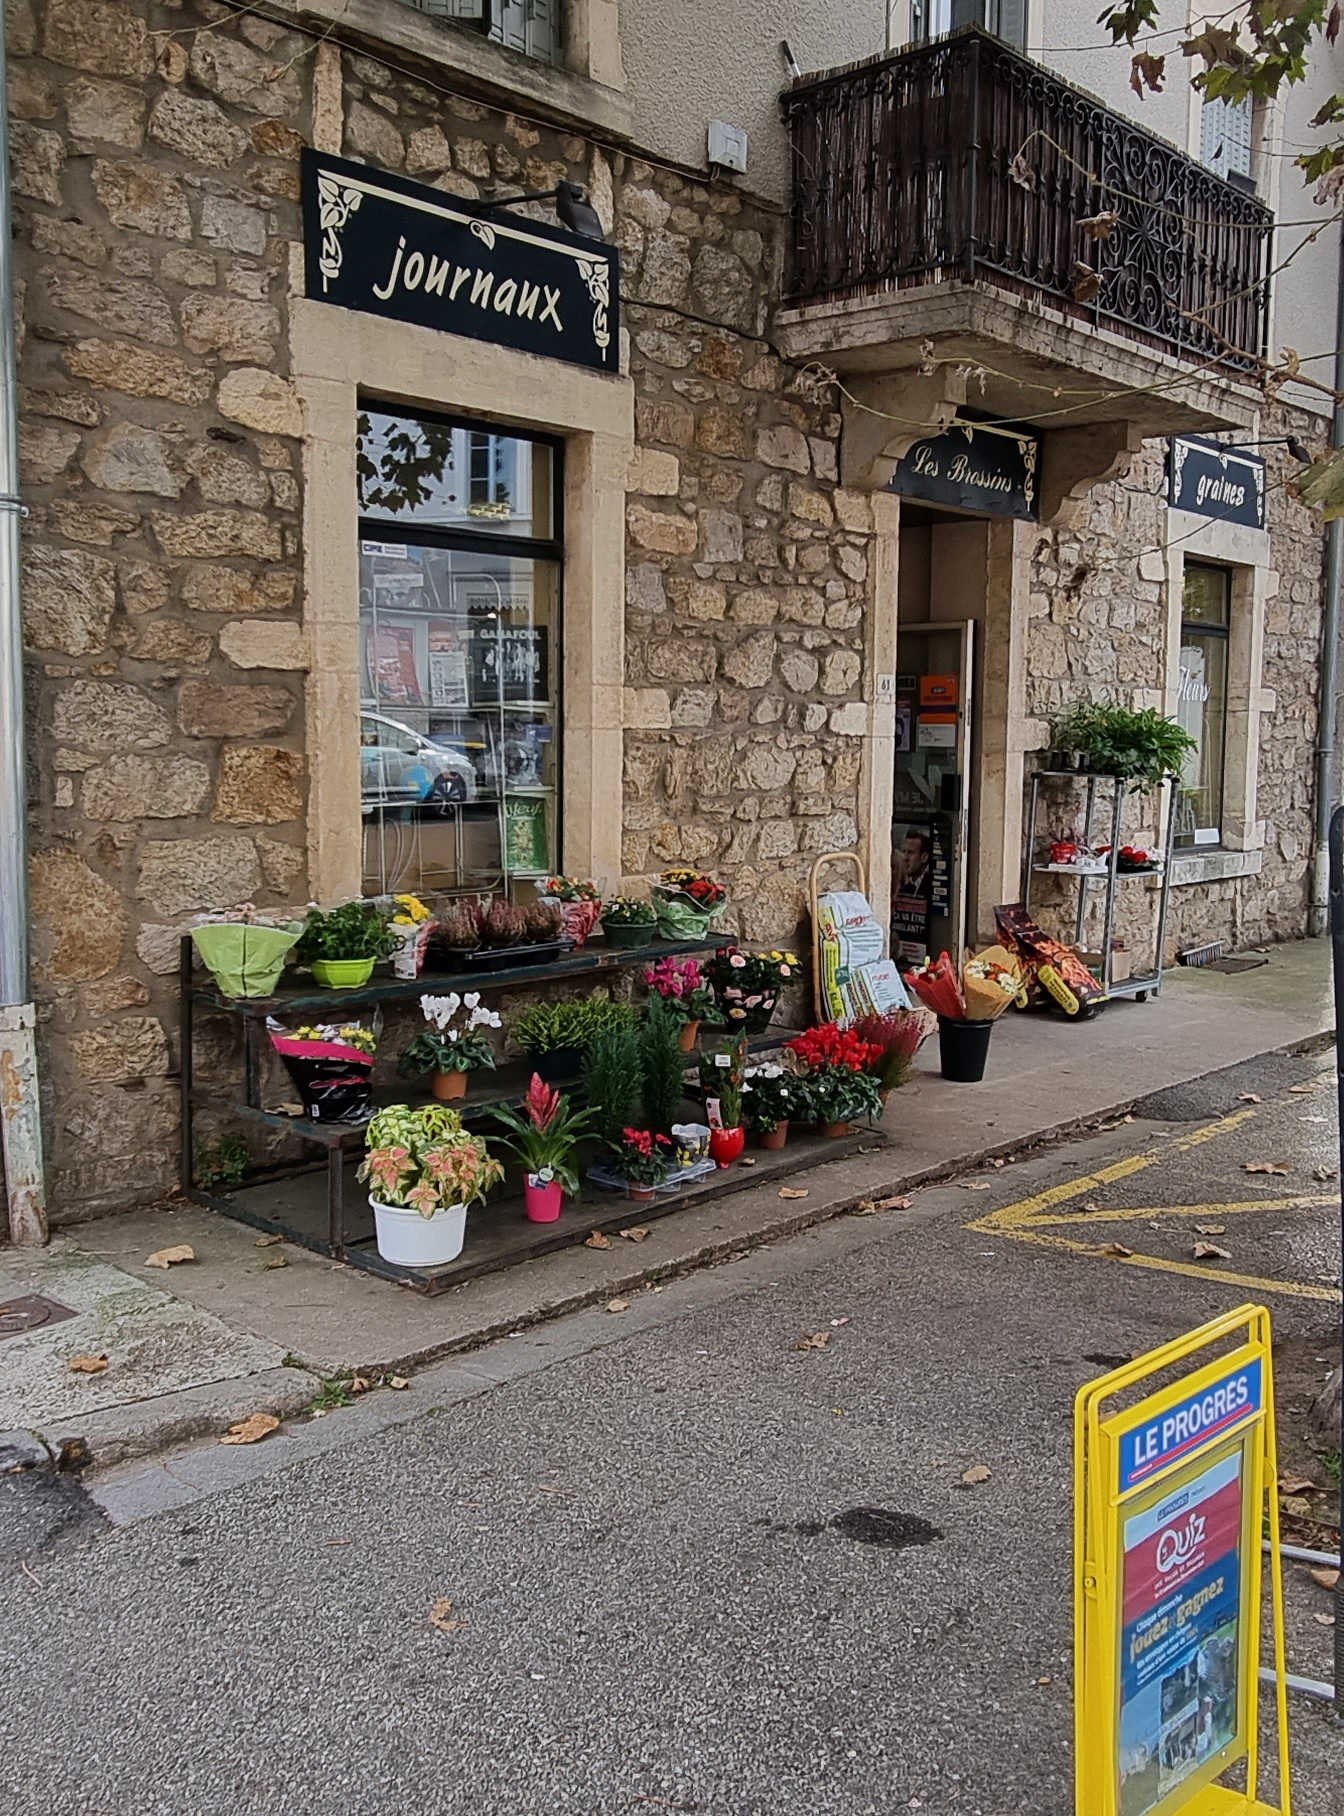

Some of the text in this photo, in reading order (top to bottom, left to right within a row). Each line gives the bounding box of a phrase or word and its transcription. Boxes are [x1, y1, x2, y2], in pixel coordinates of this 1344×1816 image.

[372, 235, 563, 332] journaux
[910, 445, 1012, 492] Les Brossins
[1196, 474, 1245, 507] graines
[881, 679, 890, 690] 61
[1134, 1426, 1158, 1467] LE
[1130, 1616, 1168, 1664] jouez
[1176, 1576, 1224, 1628] gagnez
